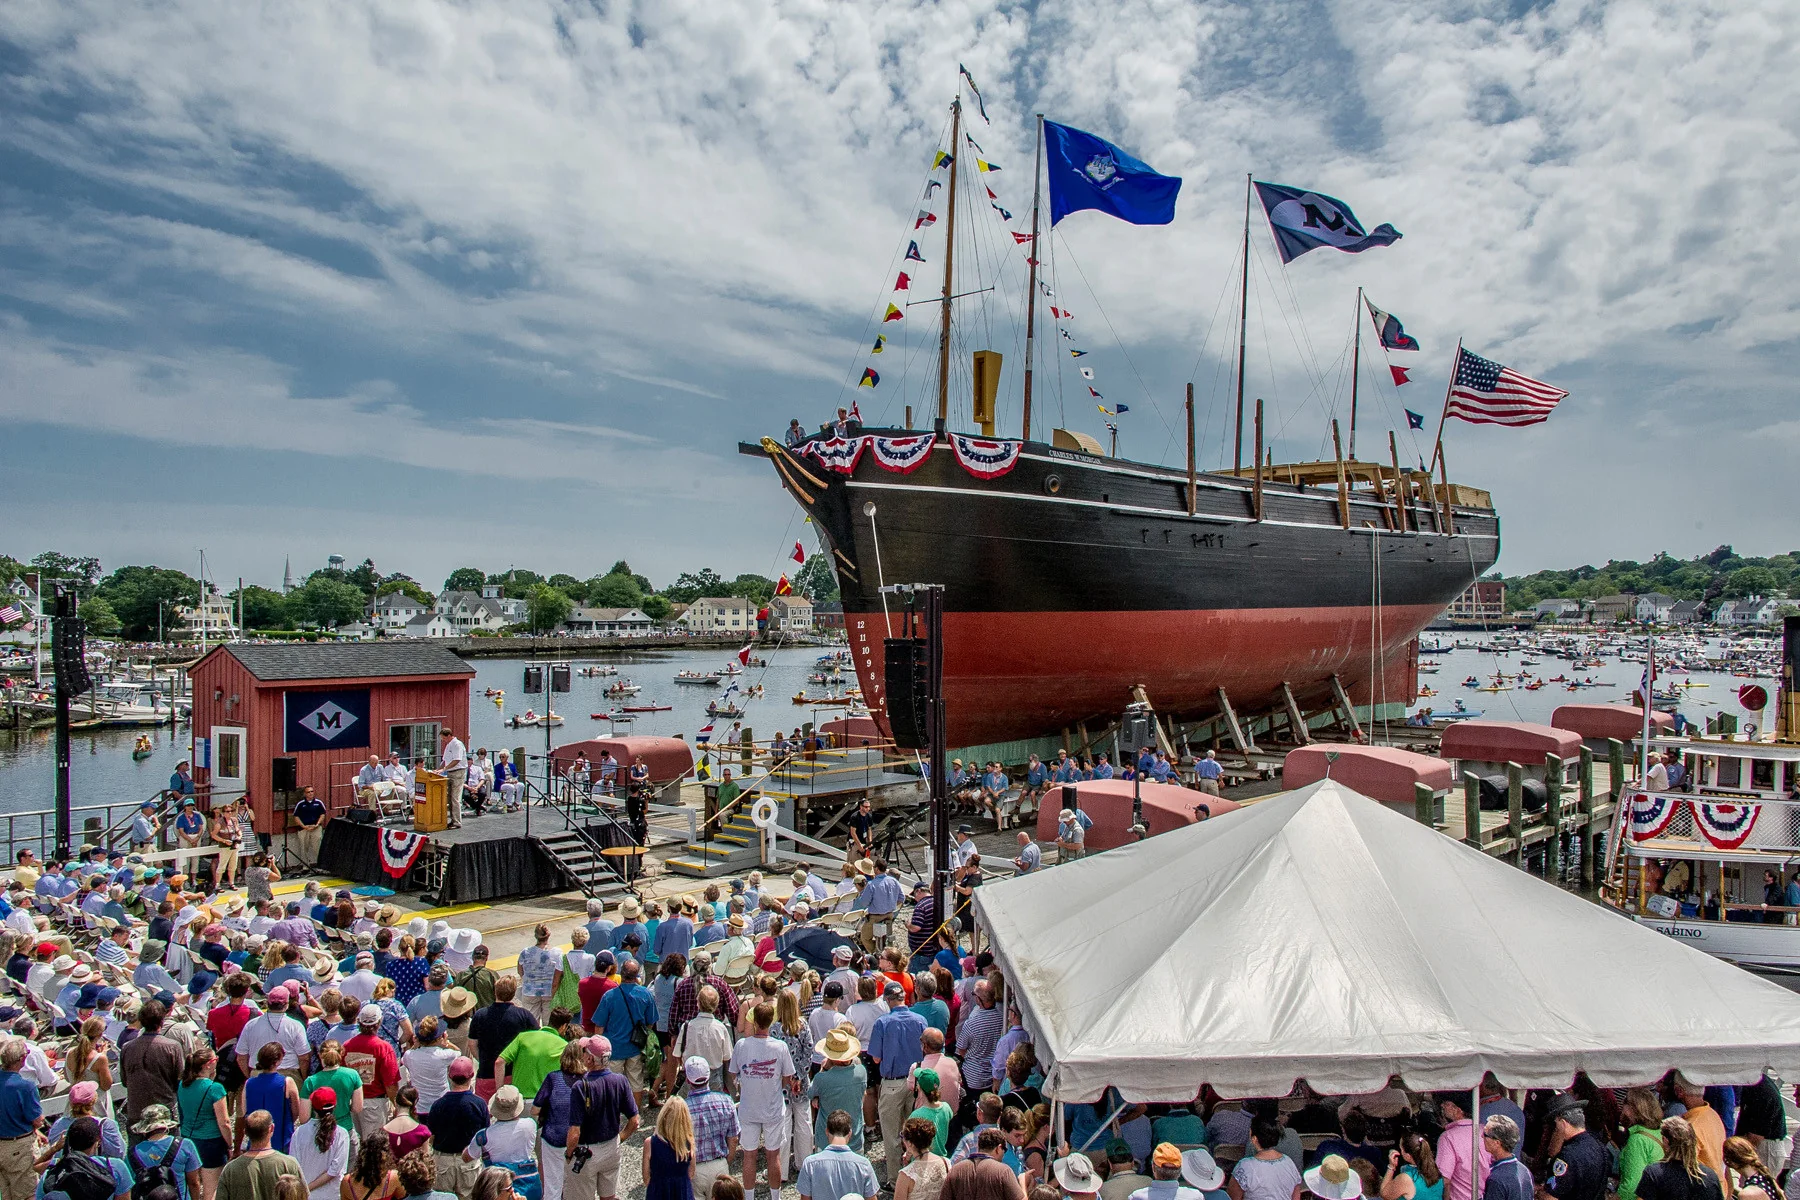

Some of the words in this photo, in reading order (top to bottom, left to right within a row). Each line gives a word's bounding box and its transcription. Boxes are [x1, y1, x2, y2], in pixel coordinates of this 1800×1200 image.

[1048, 450, 1074, 460] CHARLES
[1080, 455, 1103, 464] MORGAN
[857, 621, 865, 629] 12
[862, 646, 870, 655] 10
[870, 672, 875, 680] 8
[874, 685, 879, 693] 7
[879, 697, 884, 705] 6
[317, 711, 342, 730] M
[1656, 926, 1702, 938] SABINO
